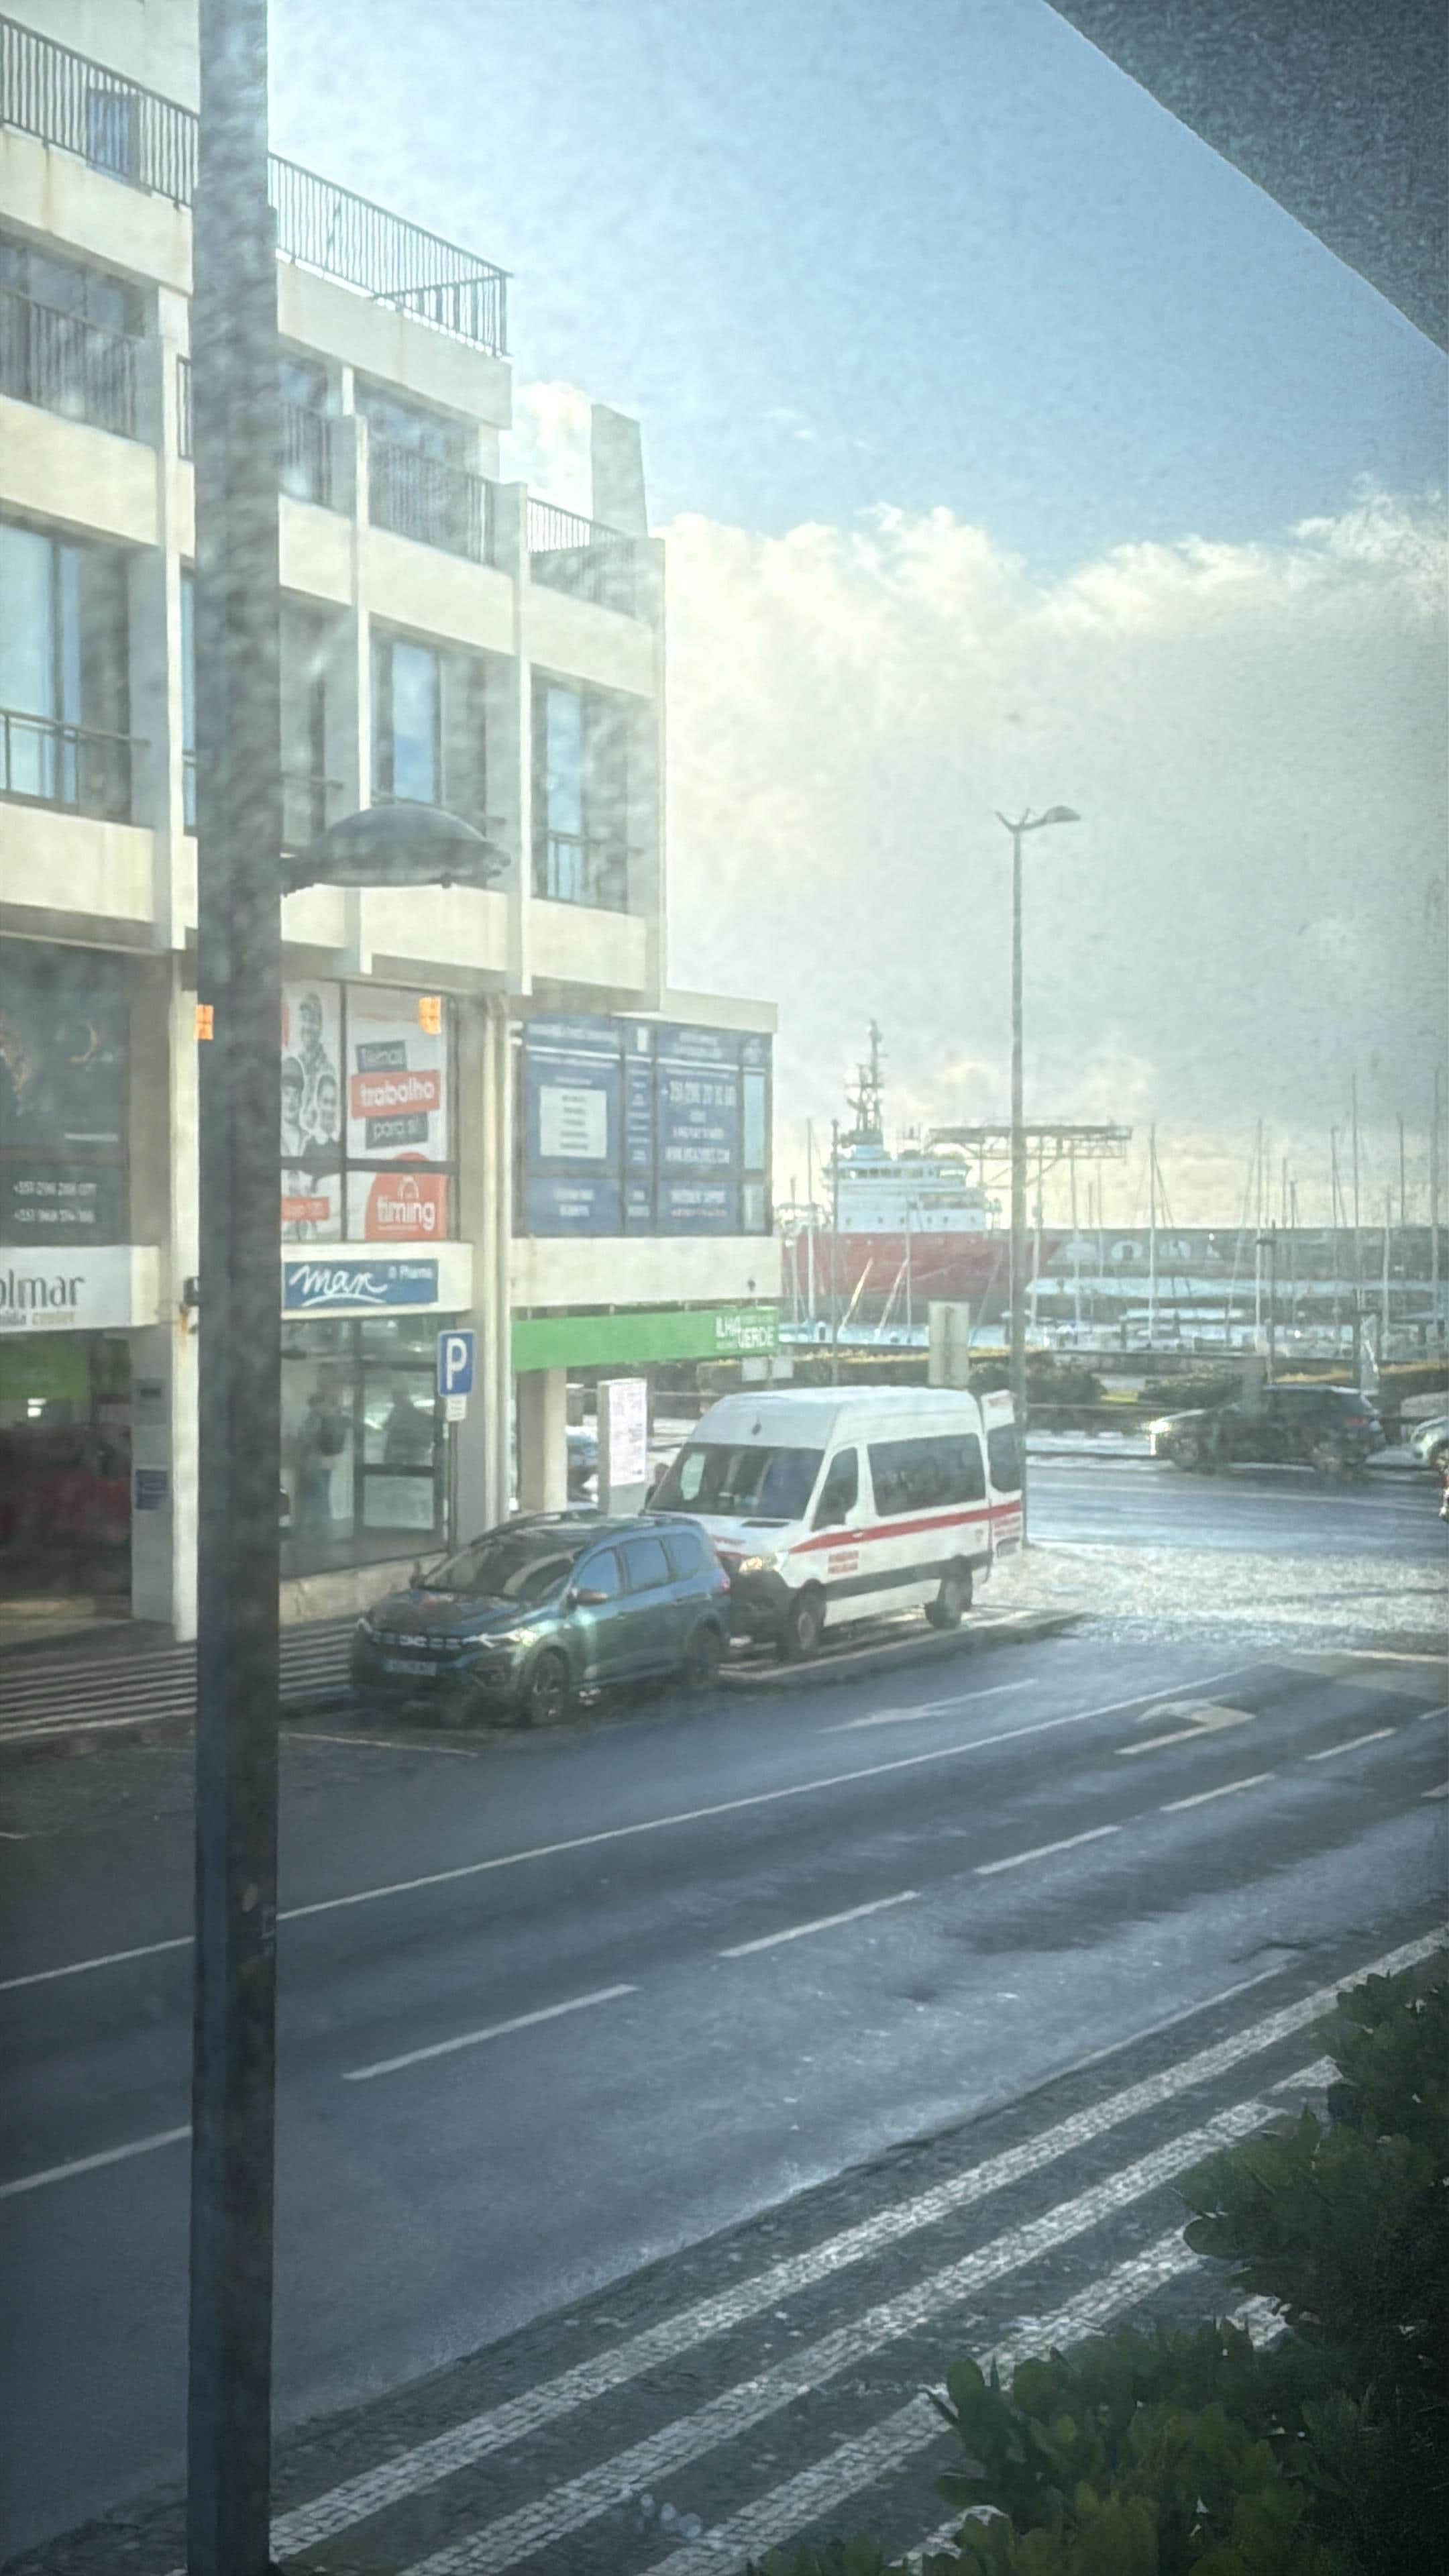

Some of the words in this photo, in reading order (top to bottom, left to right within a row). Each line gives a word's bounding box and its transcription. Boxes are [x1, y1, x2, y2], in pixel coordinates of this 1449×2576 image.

[359, 1077, 435, 1108] trabalho
[377, 1196, 435, 1230] timing
[446, 1338, 467, 1390] P
